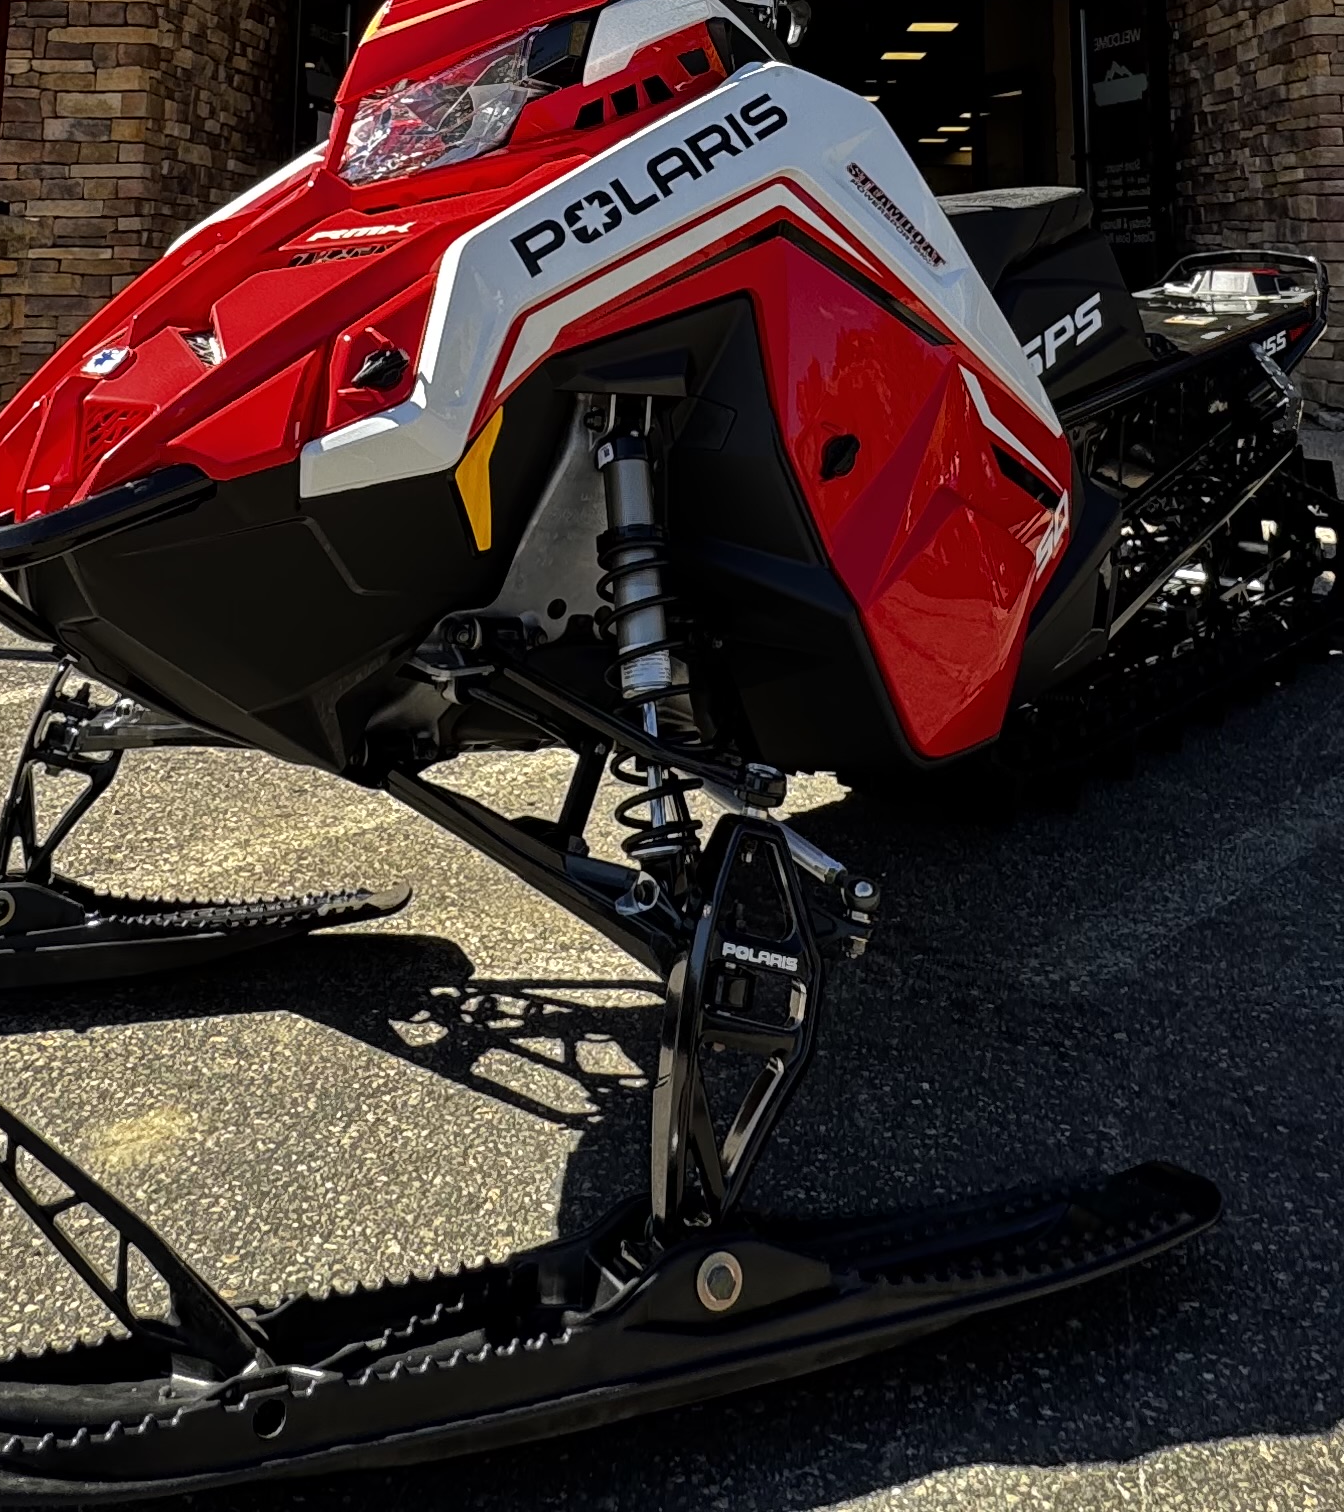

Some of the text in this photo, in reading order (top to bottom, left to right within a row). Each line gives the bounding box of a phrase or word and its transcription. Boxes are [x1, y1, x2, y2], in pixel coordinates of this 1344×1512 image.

[509, 93, 788, 278] POLARIS
[846, 162, 946, 267] STEAMBOAT
[306, 221, 417, 242] RMK
[722, 941, 798, 972] POLARIS
